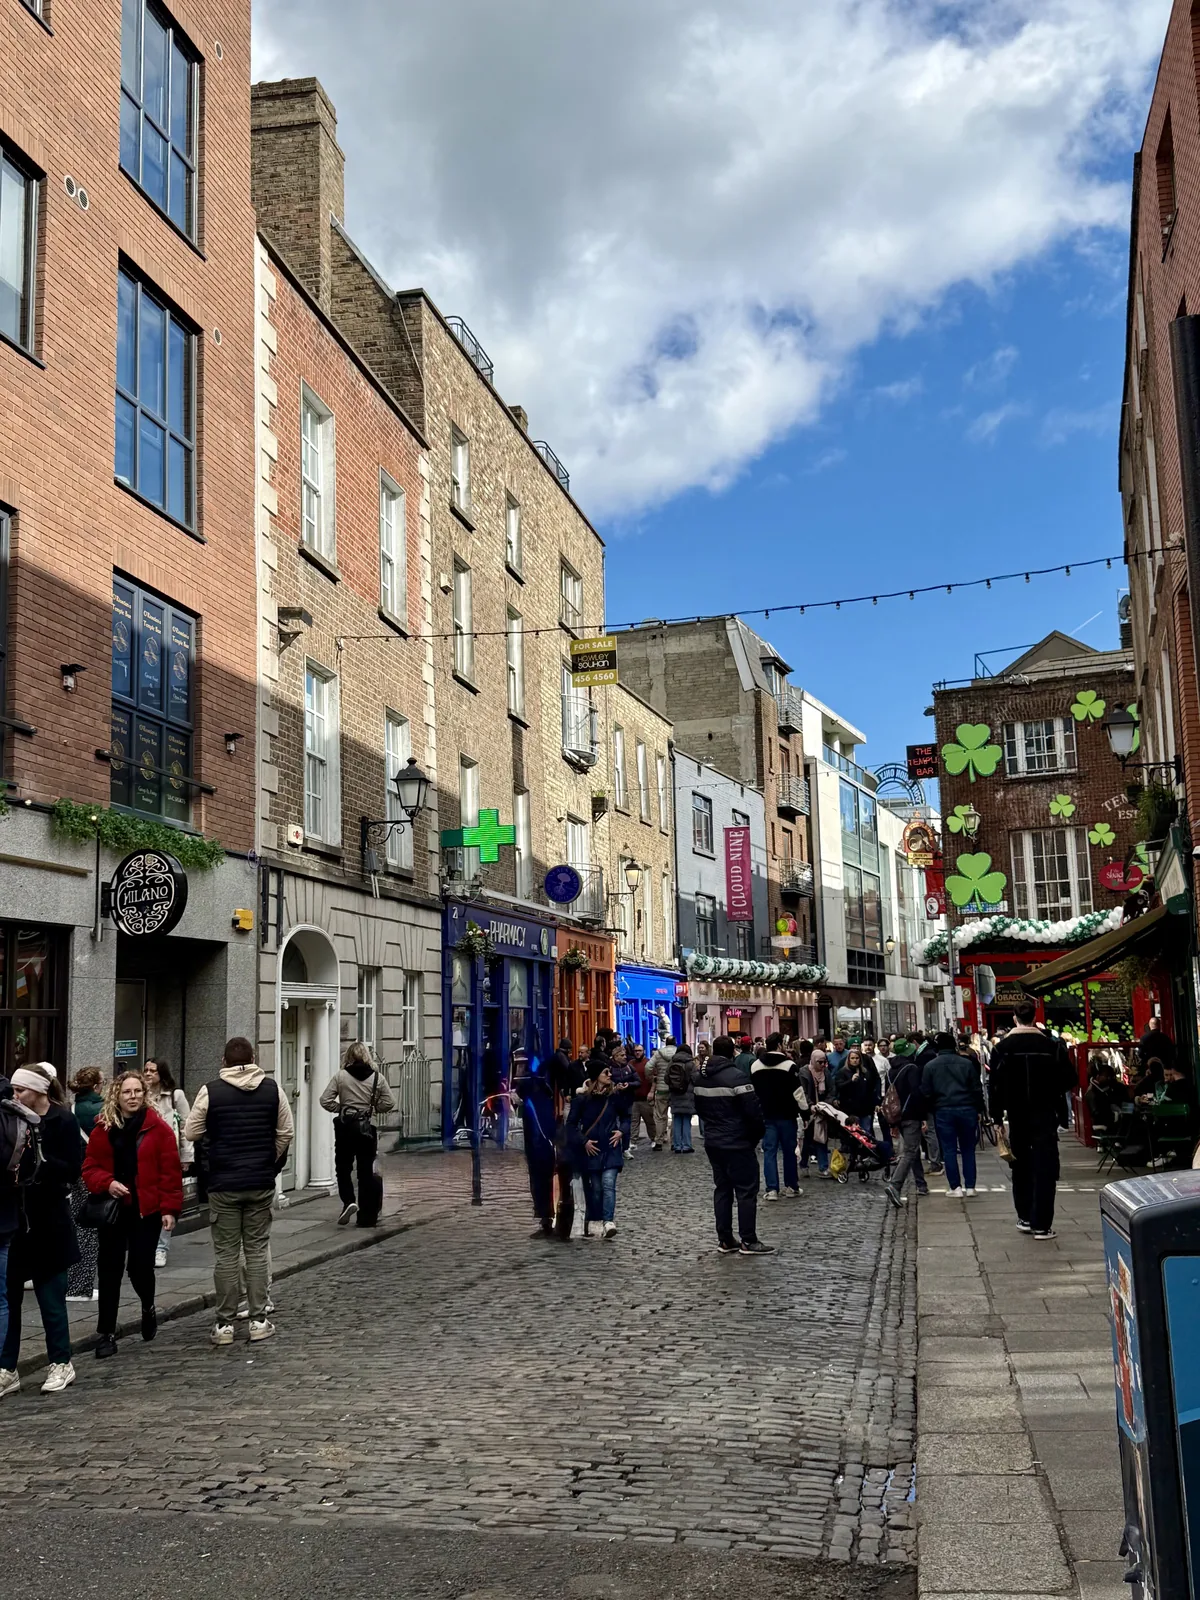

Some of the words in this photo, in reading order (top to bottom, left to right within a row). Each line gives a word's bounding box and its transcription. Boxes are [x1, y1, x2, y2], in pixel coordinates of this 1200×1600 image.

[574, 643, 591, 651] FOR
[592, 640, 613, 648] SALE
[575, 674, 591, 683] 456
[592, 672, 615, 681] 4560
[915, 747, 932, 755] THE
[916, 767, 934, 776] BAR
[729, 830, 745, 860] NINE
[730, 865, 747, 907] CLOUD
[123, 886, 169, 905] MILANO
[490, 920, 526, 947] PHARMACY
